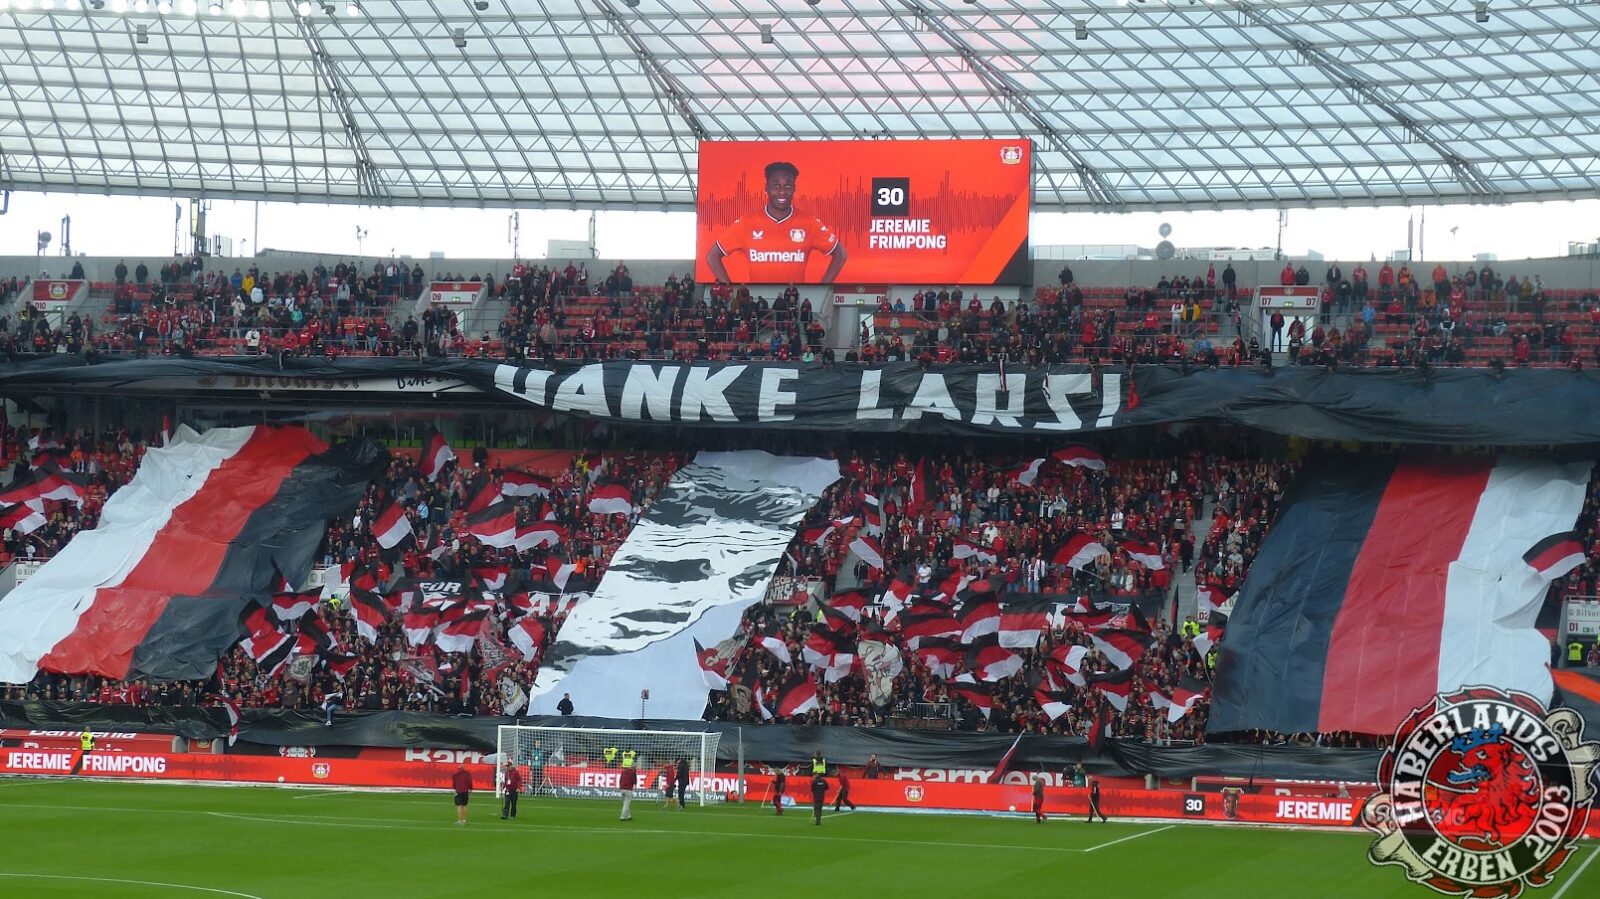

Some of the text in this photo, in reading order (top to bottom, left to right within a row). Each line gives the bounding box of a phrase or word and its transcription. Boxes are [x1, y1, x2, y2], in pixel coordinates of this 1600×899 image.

[877, 188, 904, 206] 30
[869, 219, 931, 233] JEREMIE
[869, 235, 947, 249] FRIMPONG
[749, 249, 805, 262] Barmenia
[1261, 297, 1272, 306] D7
[1306, 297, 1317, 306] D7
[6, 752, 166, 773] JEREMIE FRIMPONG
[1186, 799, 1203, 811] 30
[1276, 800, 1353, 820] JEREMIE
